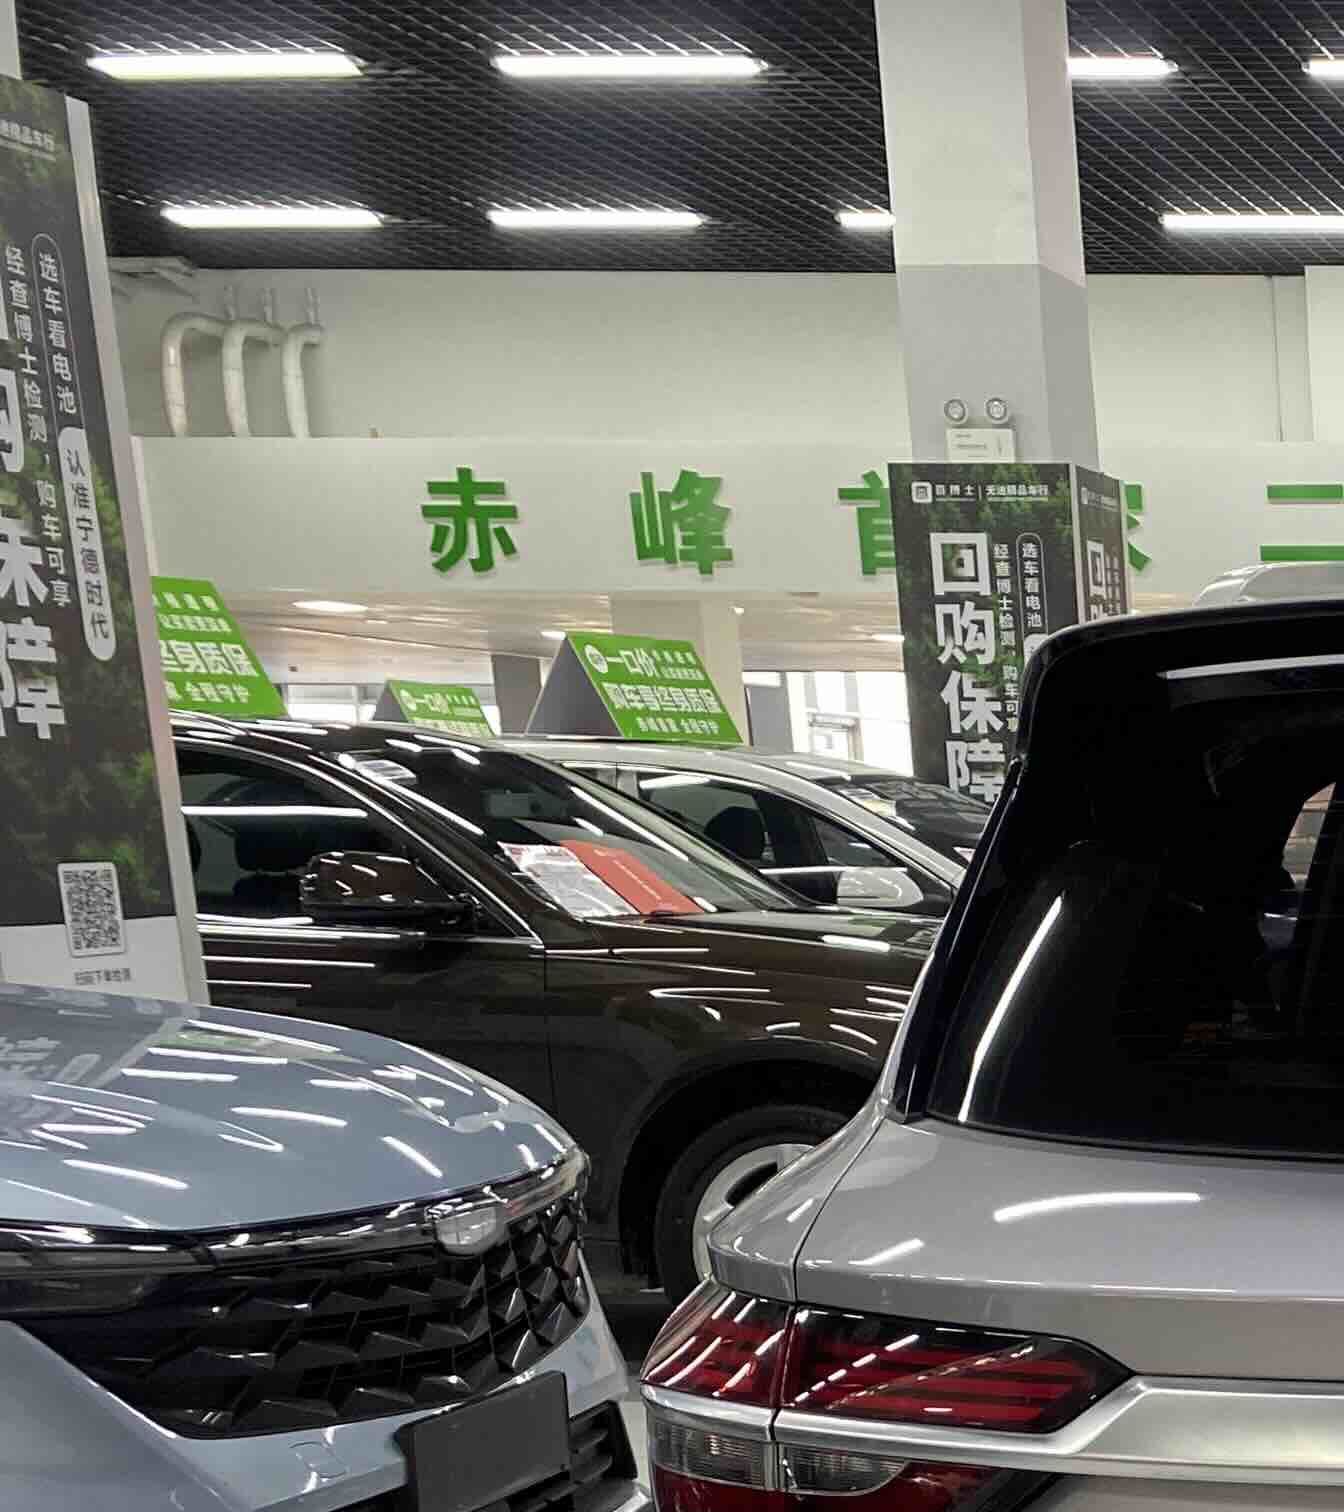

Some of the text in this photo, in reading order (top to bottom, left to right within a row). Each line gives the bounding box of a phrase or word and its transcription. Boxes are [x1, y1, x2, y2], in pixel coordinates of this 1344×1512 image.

[38, 252, 78, 415] 选车看电池
[929, 532, 1005, 802] 回购保障
[1022, 543, 1045, 629] 选车看电池
